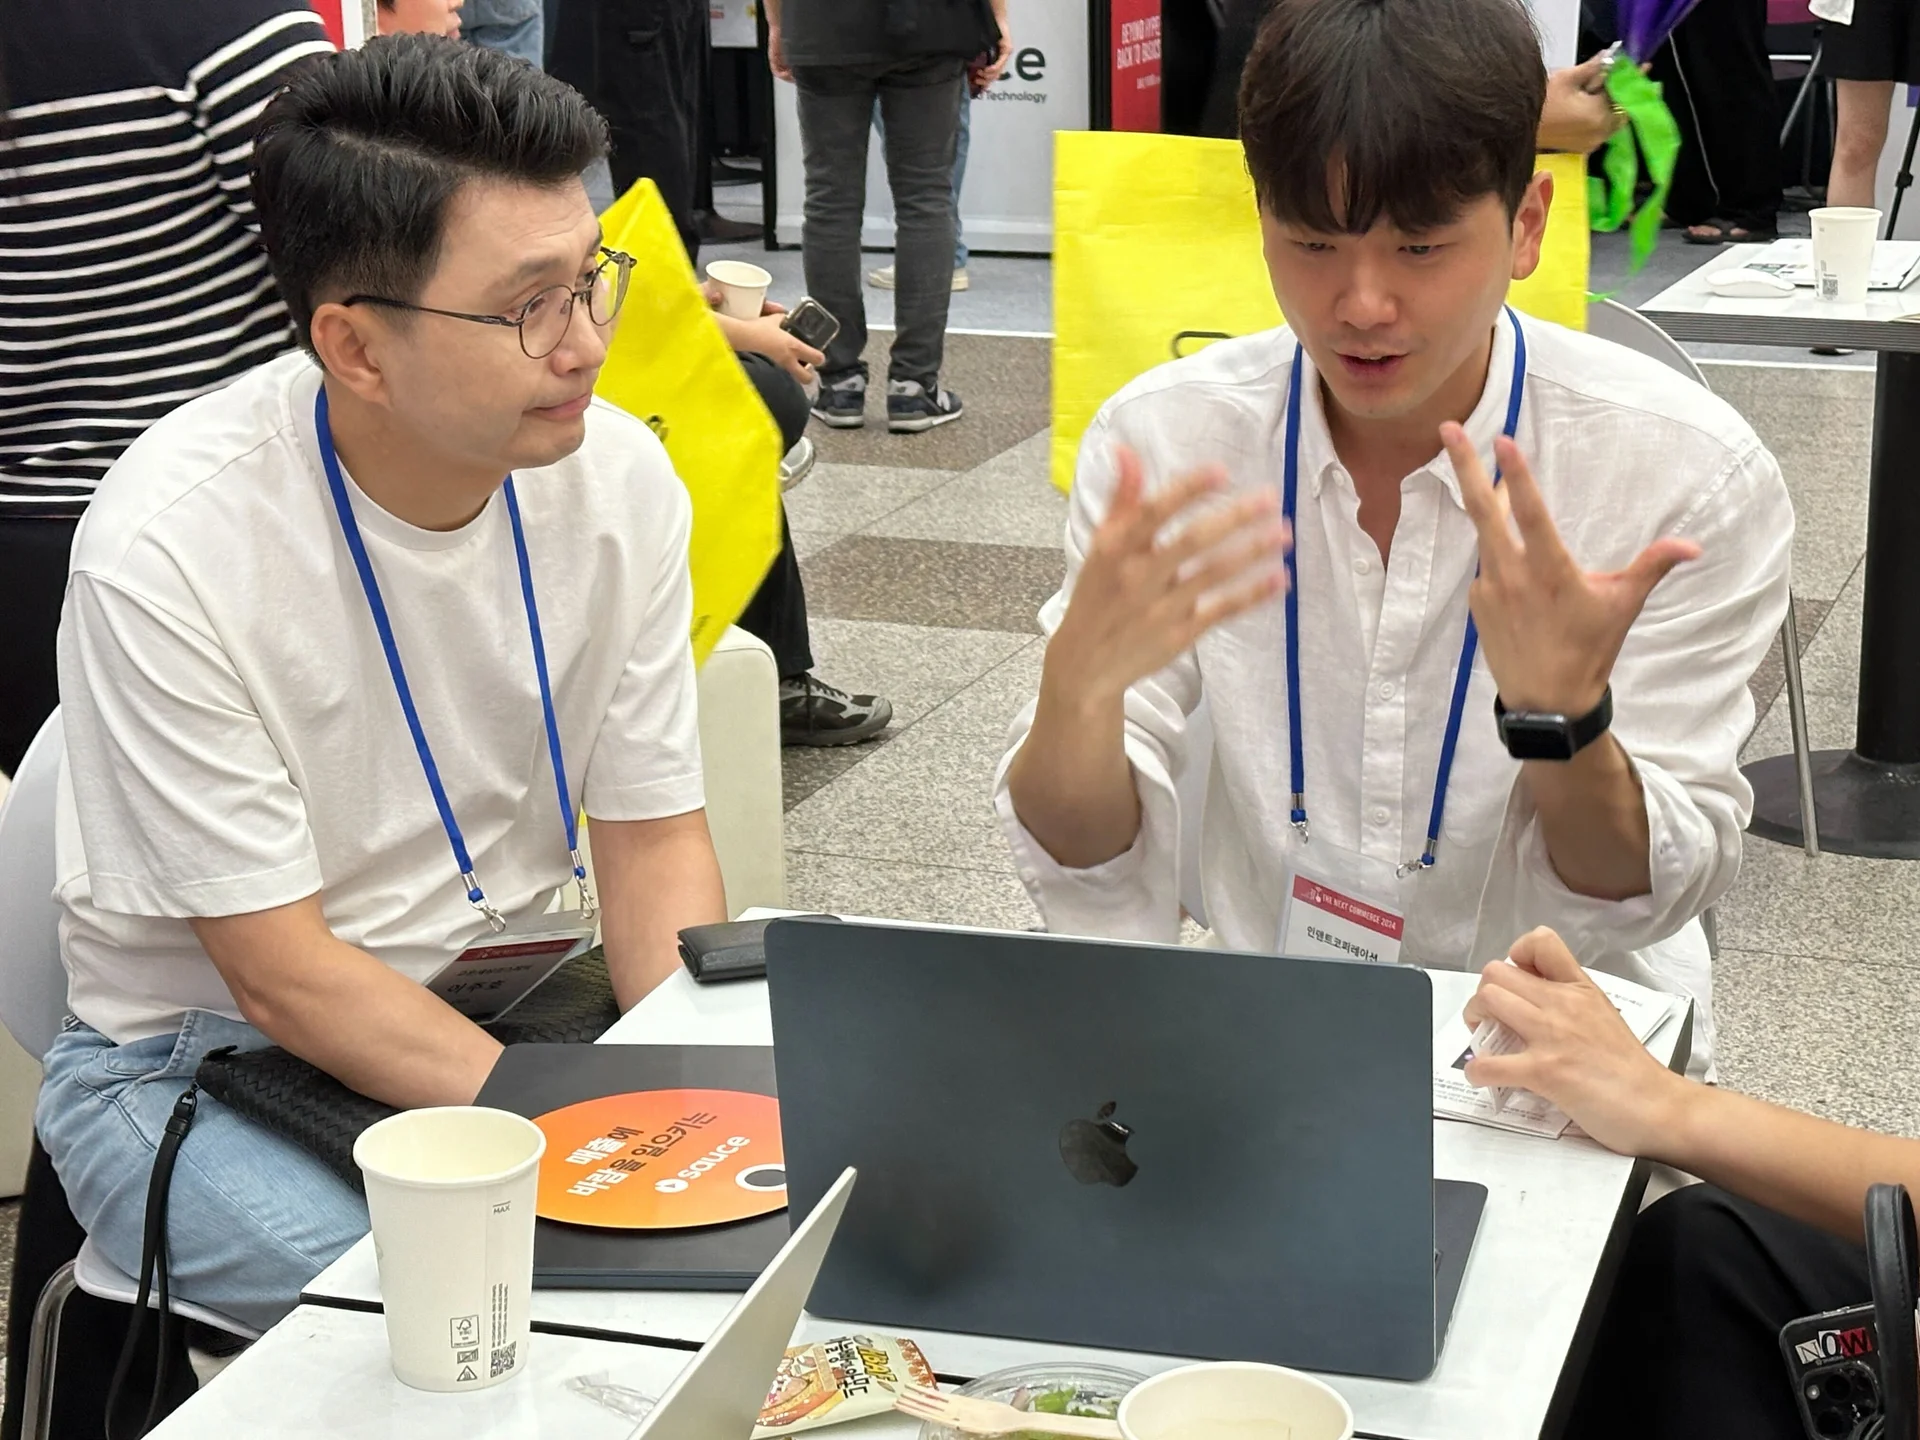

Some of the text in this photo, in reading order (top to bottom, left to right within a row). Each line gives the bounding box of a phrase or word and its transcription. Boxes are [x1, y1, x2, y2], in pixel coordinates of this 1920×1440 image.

[987, 90, 1047, 104] Technology
[1322, 893, 1397, 931] THE NEXT COMMERCE 2024
[565, 1126, 644, 1166] 매출에
[566, 1112, 718, 1197] 바람을 일으키는
[678, 1135, 751, 1180] sauce
[493, 1205, 511, 1214] MAX
[857, 1345, 898, 1383] HBAF
[1797, 1329, 1870, 1363] NOW
